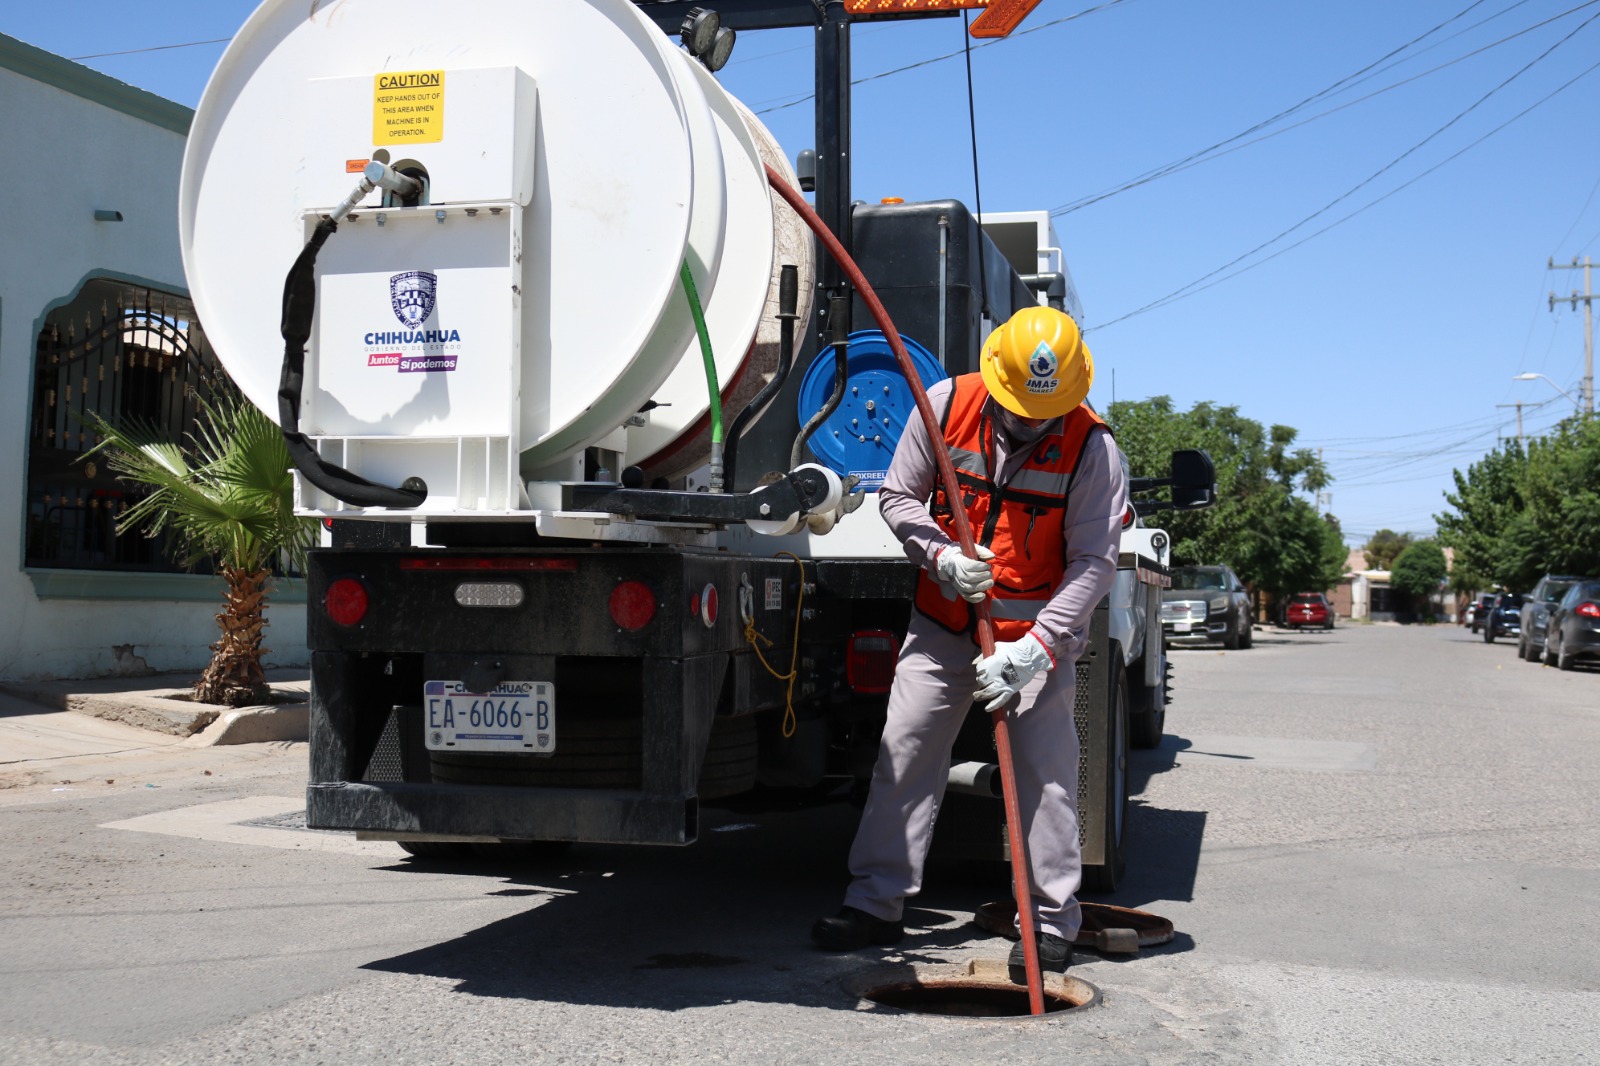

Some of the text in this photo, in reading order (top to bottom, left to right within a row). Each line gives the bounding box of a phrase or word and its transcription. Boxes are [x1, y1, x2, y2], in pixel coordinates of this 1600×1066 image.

[379, 73, 440, 88] CAUTION
[377, 92, 441, 103] KEEP HANDS OUT OF
[386, 117, 415, 125] MACHINE
[388, 128, 426, 137] OPERATION.
[364, 329, 461, 345] CHIHUAHUA
[369, 355, 399, 365] Juntos
[410, 358, 455, 371] podemos
[1026, 379, 1058, 388] JMAS
[429, 698, 549, 730] EA-6066-B
